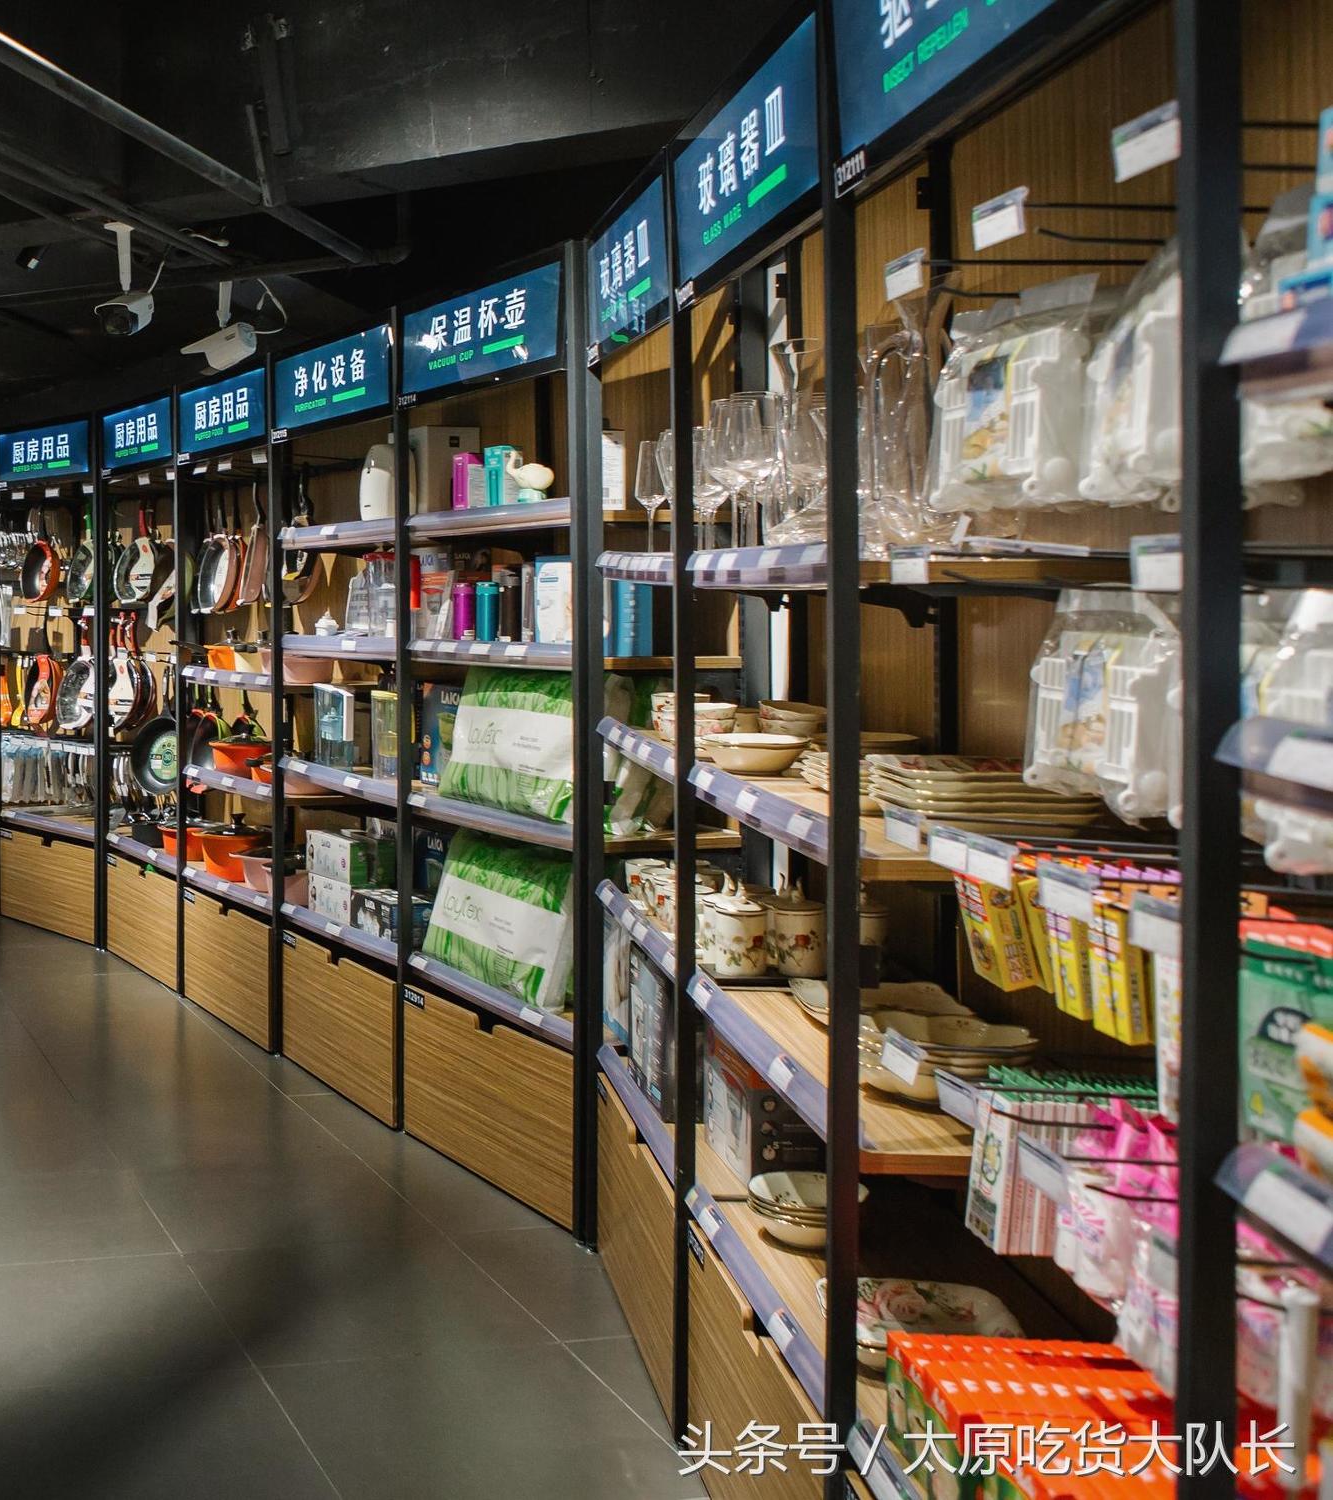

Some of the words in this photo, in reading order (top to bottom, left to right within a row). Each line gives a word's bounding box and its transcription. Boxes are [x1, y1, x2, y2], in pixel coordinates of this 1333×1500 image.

[698, 85, 786, 215] 玻璃器皿
[836, 150, 866, 186] 312111
[600, 219, 651, 299] 玻璃器皿
[428, 288, 527, 353] 保温杯壶
[294, 348, 366, 398] 净化设备
[428, 354, 457, 370] VACUUM
[458, 349, 474, 362] CUP
[115, 413, 158, 449] 厨房用品
[195, 387, 249, 431] 厨房用品
[12, 434, 70, 465] 厨房用品
